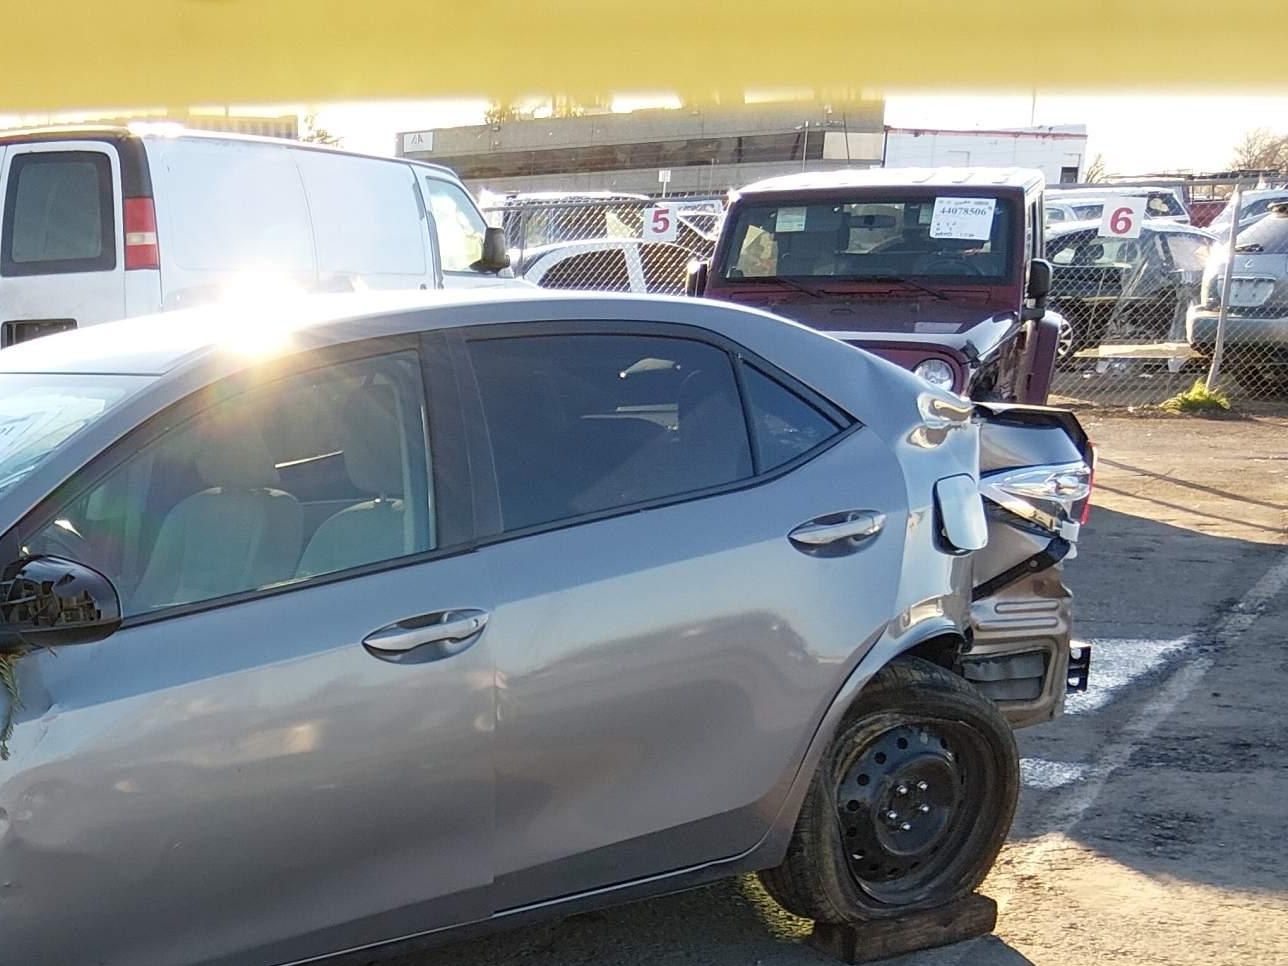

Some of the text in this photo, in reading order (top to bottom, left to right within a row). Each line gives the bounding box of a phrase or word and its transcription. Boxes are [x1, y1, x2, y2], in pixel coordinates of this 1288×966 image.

[652, 208, 670, 234] 5
[939, 206, 987, 217] 44078506
[1110, 207, 1134, 235] 6
